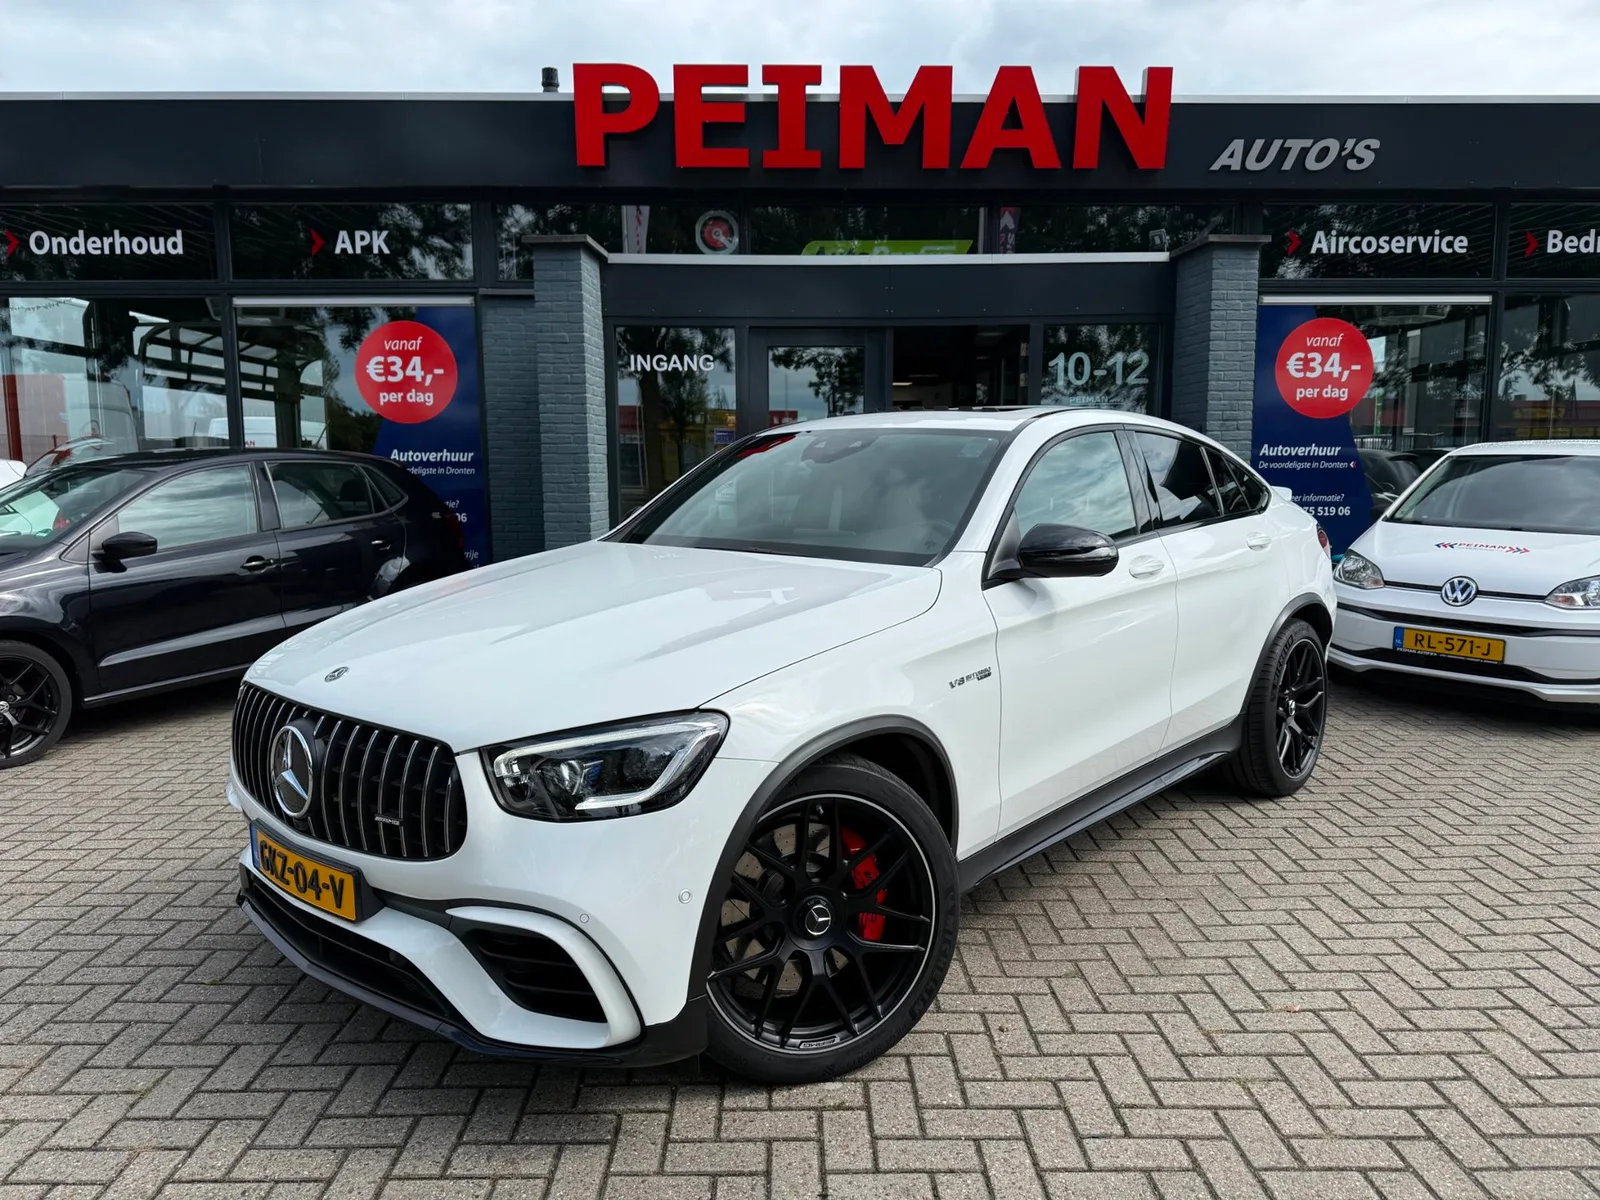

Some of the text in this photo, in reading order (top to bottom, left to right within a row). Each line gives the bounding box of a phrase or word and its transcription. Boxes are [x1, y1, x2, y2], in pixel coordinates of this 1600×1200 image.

[573, 63, 1381, 171] PEIMAN AUTO'S
[28, 229, 184, 255] Onderhoud
[334, 229, 391, 255] APK
[1310, 229, 1469, 254] Aircoservice
[384, 336, 423, 351] vanaf
[1306, 332, 1344, 347] vanaf
[366, 355, 445, 387] €34,-
[630, 354, 714, 372] INGANG
[1048, 351, 1150, 386] 10-12
[1286, 352, 1361, 382] €34,-
[379, 388, 434, 406] per dag
[1296, 384, 1349, 401] per dag
[390, 448, 474, 462] Autoverhuur
[1259, 443, 1341, 456] Autoverhuur
[438, 466, 445, 475] in
[446, 466, 475, 475] Dronten
[1258, 460, 1348, 471] De voordeligste in Dronten
[1302, 493, 1345, 502] informatie?
[1317, 506, 1336, 516] 519
[1338, 506, 1351, 516] 06
[1414, 632, 1491, 657] RL-571-J
[259, 839, 345, 909] GKZ-04-V
